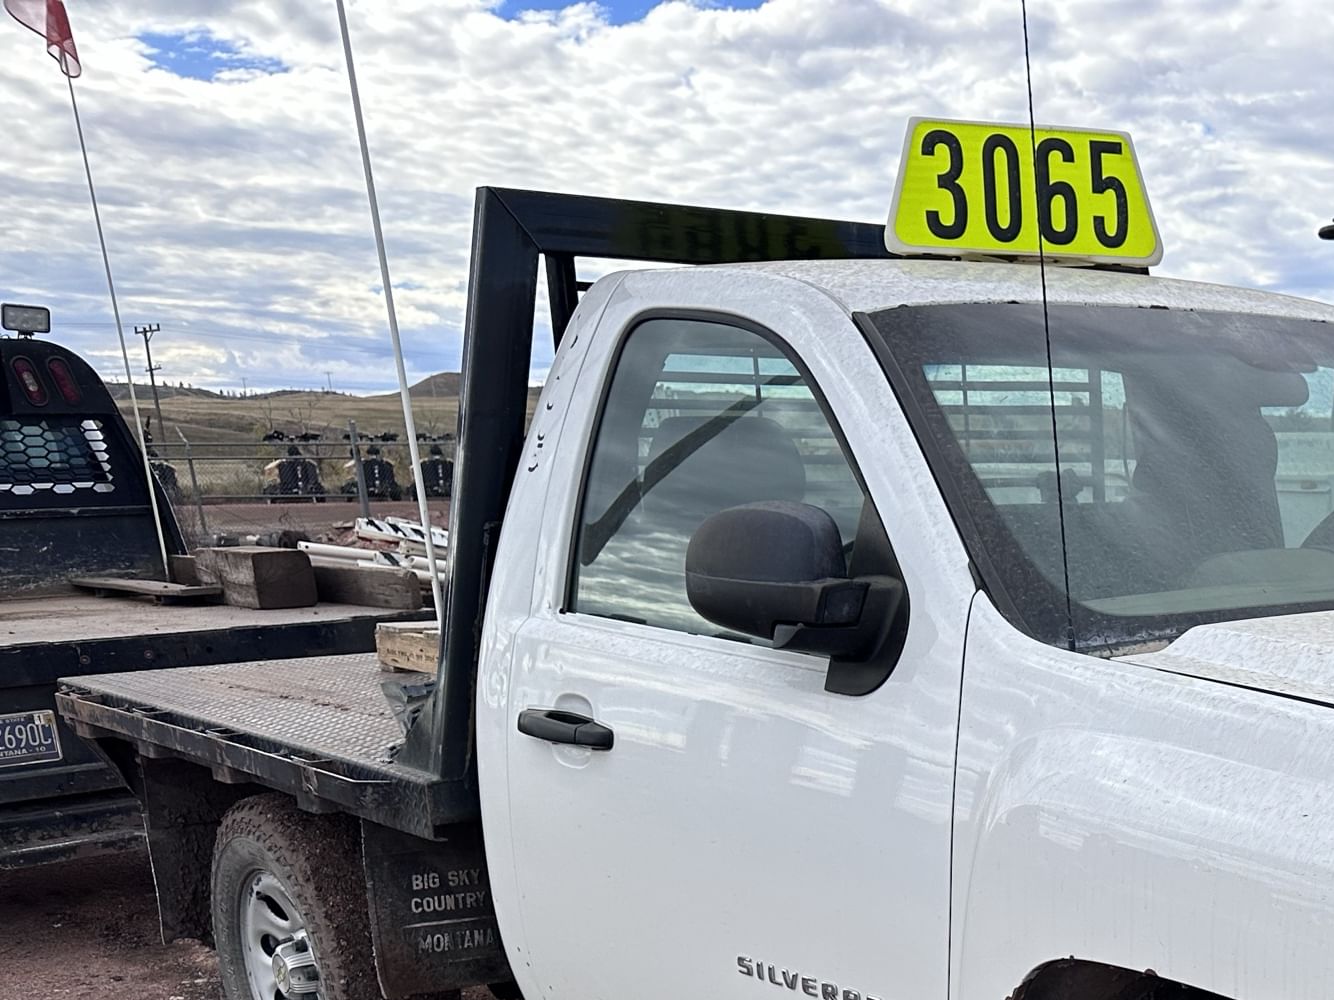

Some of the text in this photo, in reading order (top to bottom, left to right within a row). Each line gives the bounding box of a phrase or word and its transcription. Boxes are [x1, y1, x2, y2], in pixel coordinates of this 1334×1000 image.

[921, 129, 1129, 248] 3065
[411, 869, 481, 890] BIG SKY
[411, 891, 486, 913] COUNTRY
[418, 928, 495, 954] MONTANA
